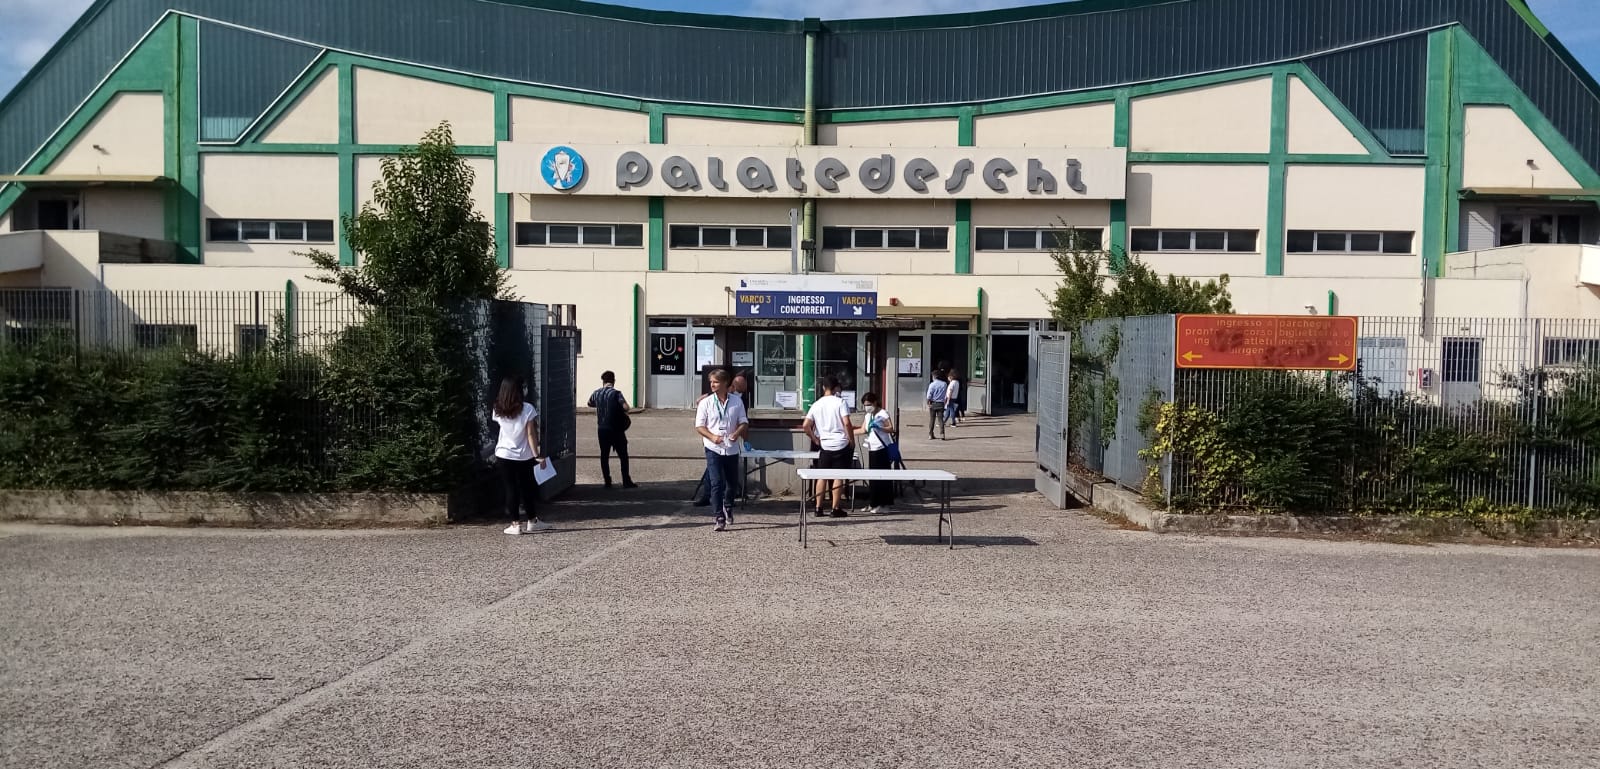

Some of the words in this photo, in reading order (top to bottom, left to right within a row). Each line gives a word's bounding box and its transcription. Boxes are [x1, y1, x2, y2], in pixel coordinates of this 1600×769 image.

[739, 295, 764, 304] VARCO
[765, 295, 772, 304] 3
[787, 295, 826, 305] INGRESSO
[841, 296, 867, 305] VARCO
[867, 296, 874, 305] 4
[780, 305, 833, 315] CONCORRENTI
[1216, 319, 1262, 328] ingresso
[905, 347, 913, 358] 3
